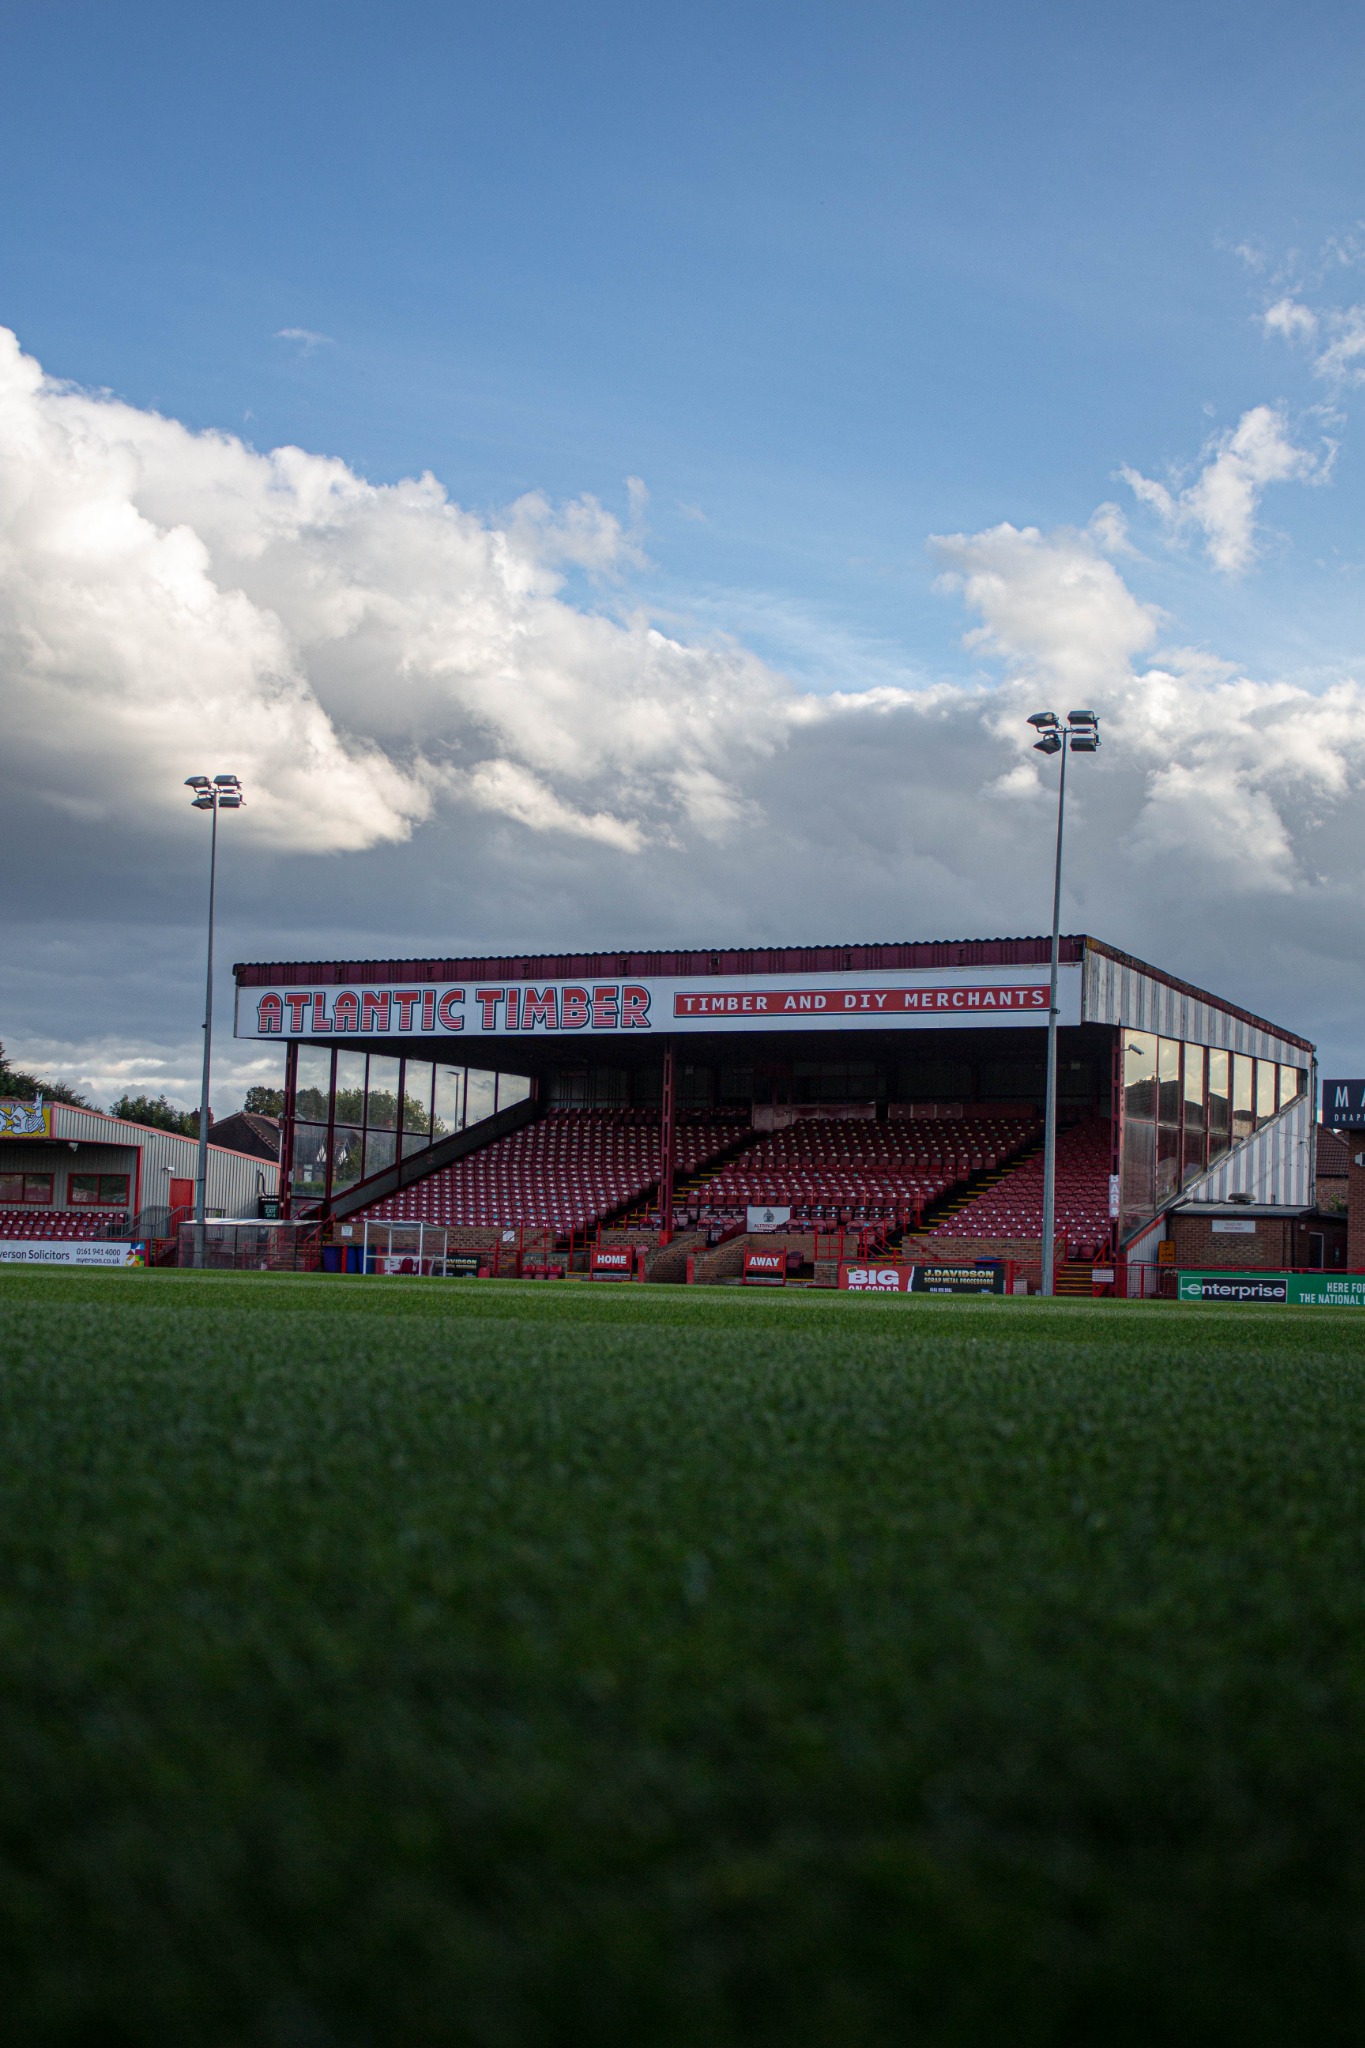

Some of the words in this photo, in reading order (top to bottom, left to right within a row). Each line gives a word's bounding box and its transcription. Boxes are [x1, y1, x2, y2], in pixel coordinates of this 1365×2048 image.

[684, 996, 768, 1011] TIMBER
[784, 995, 827, 1009] AND
[844, 994, 887, 1008] DIY
[904, 990, 1044, 1007] MERCHANTS
[256, 988, 466, 1033] ATLANTIC
[476, 985, 652, 1031] TIMBER
[1110, 1174, 1120, 1204] BAR
[28, 1249, 70, 1261] Solicitors
[92, 1248, 104, 1256] 941
[105, 1248, 121, 1256] 4000
[597, 1254, 627, 1265] HOME
[749, 1256, 780, 1267] AWAY
[848, 1269, 900, 1285] BIG
[924, 1269, 995, 1278] J.DAVIDSON
[1186, 1283, 1286, 1299] enterprise
[1326, 1282, 1349, 1293] HERE
[1299, 1293, 1316, 1303] THE
[1318, 1294, 1361, 1305] NATIONAL
